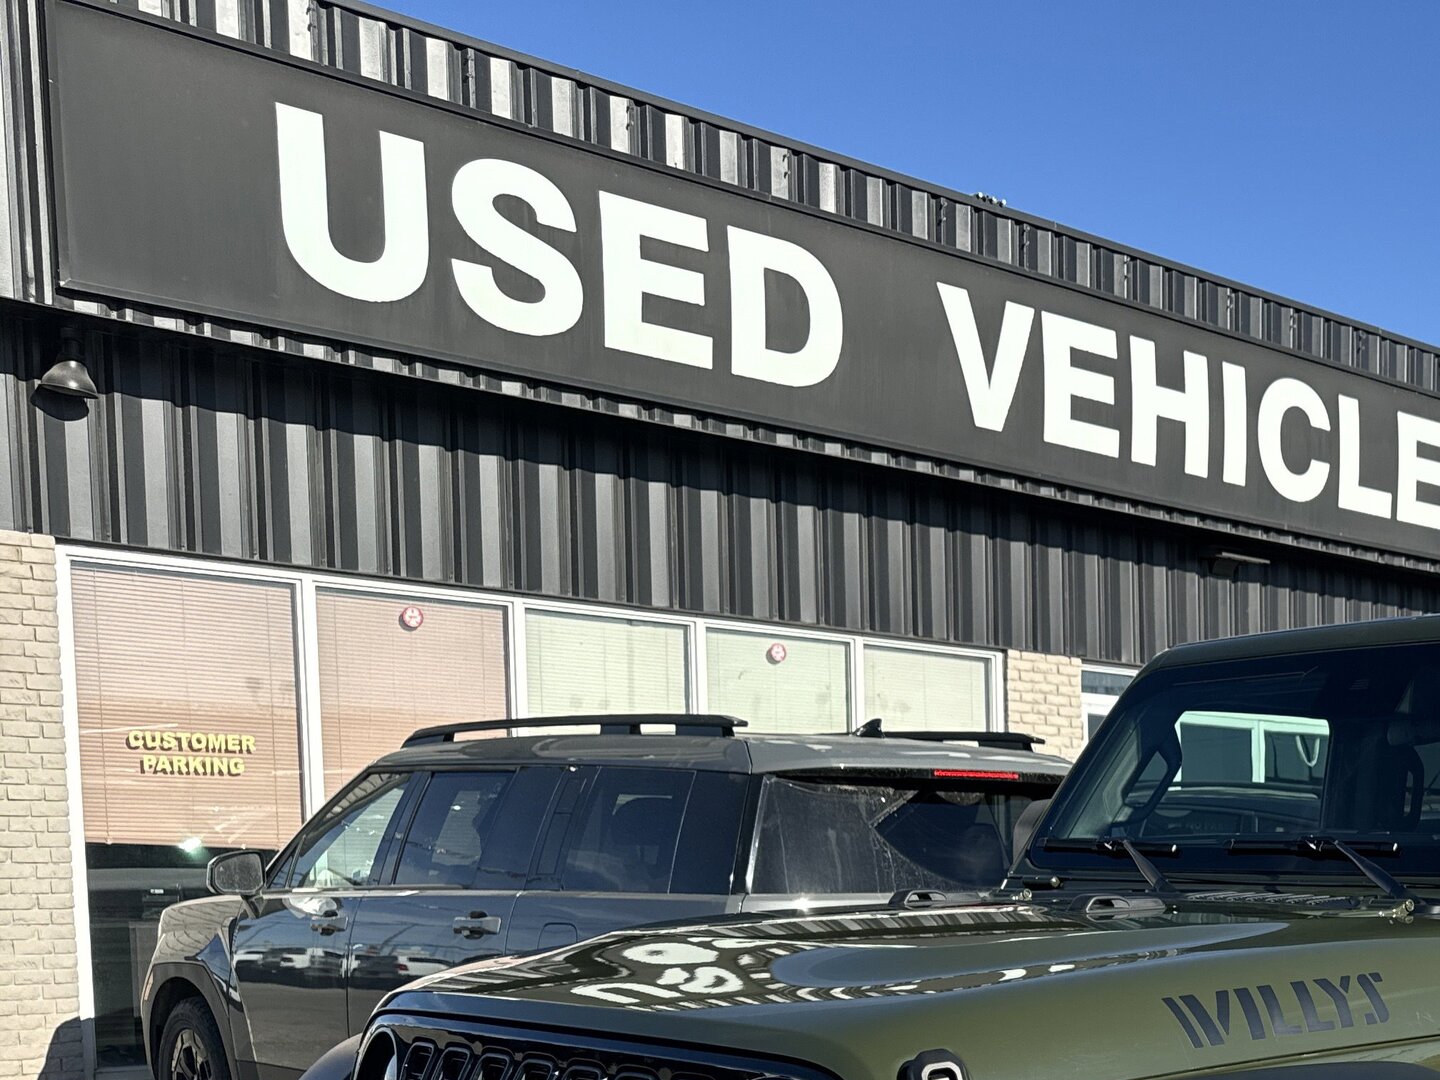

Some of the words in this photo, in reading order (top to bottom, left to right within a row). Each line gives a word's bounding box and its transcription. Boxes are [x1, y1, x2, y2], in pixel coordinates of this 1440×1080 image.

[274, 101, 843, 387] USED
[126, 731, 256, 753] CUSTOMER
[140, 754, 245, 776] PARKING
[1161, 972, 1390, 1049] WILLYS
